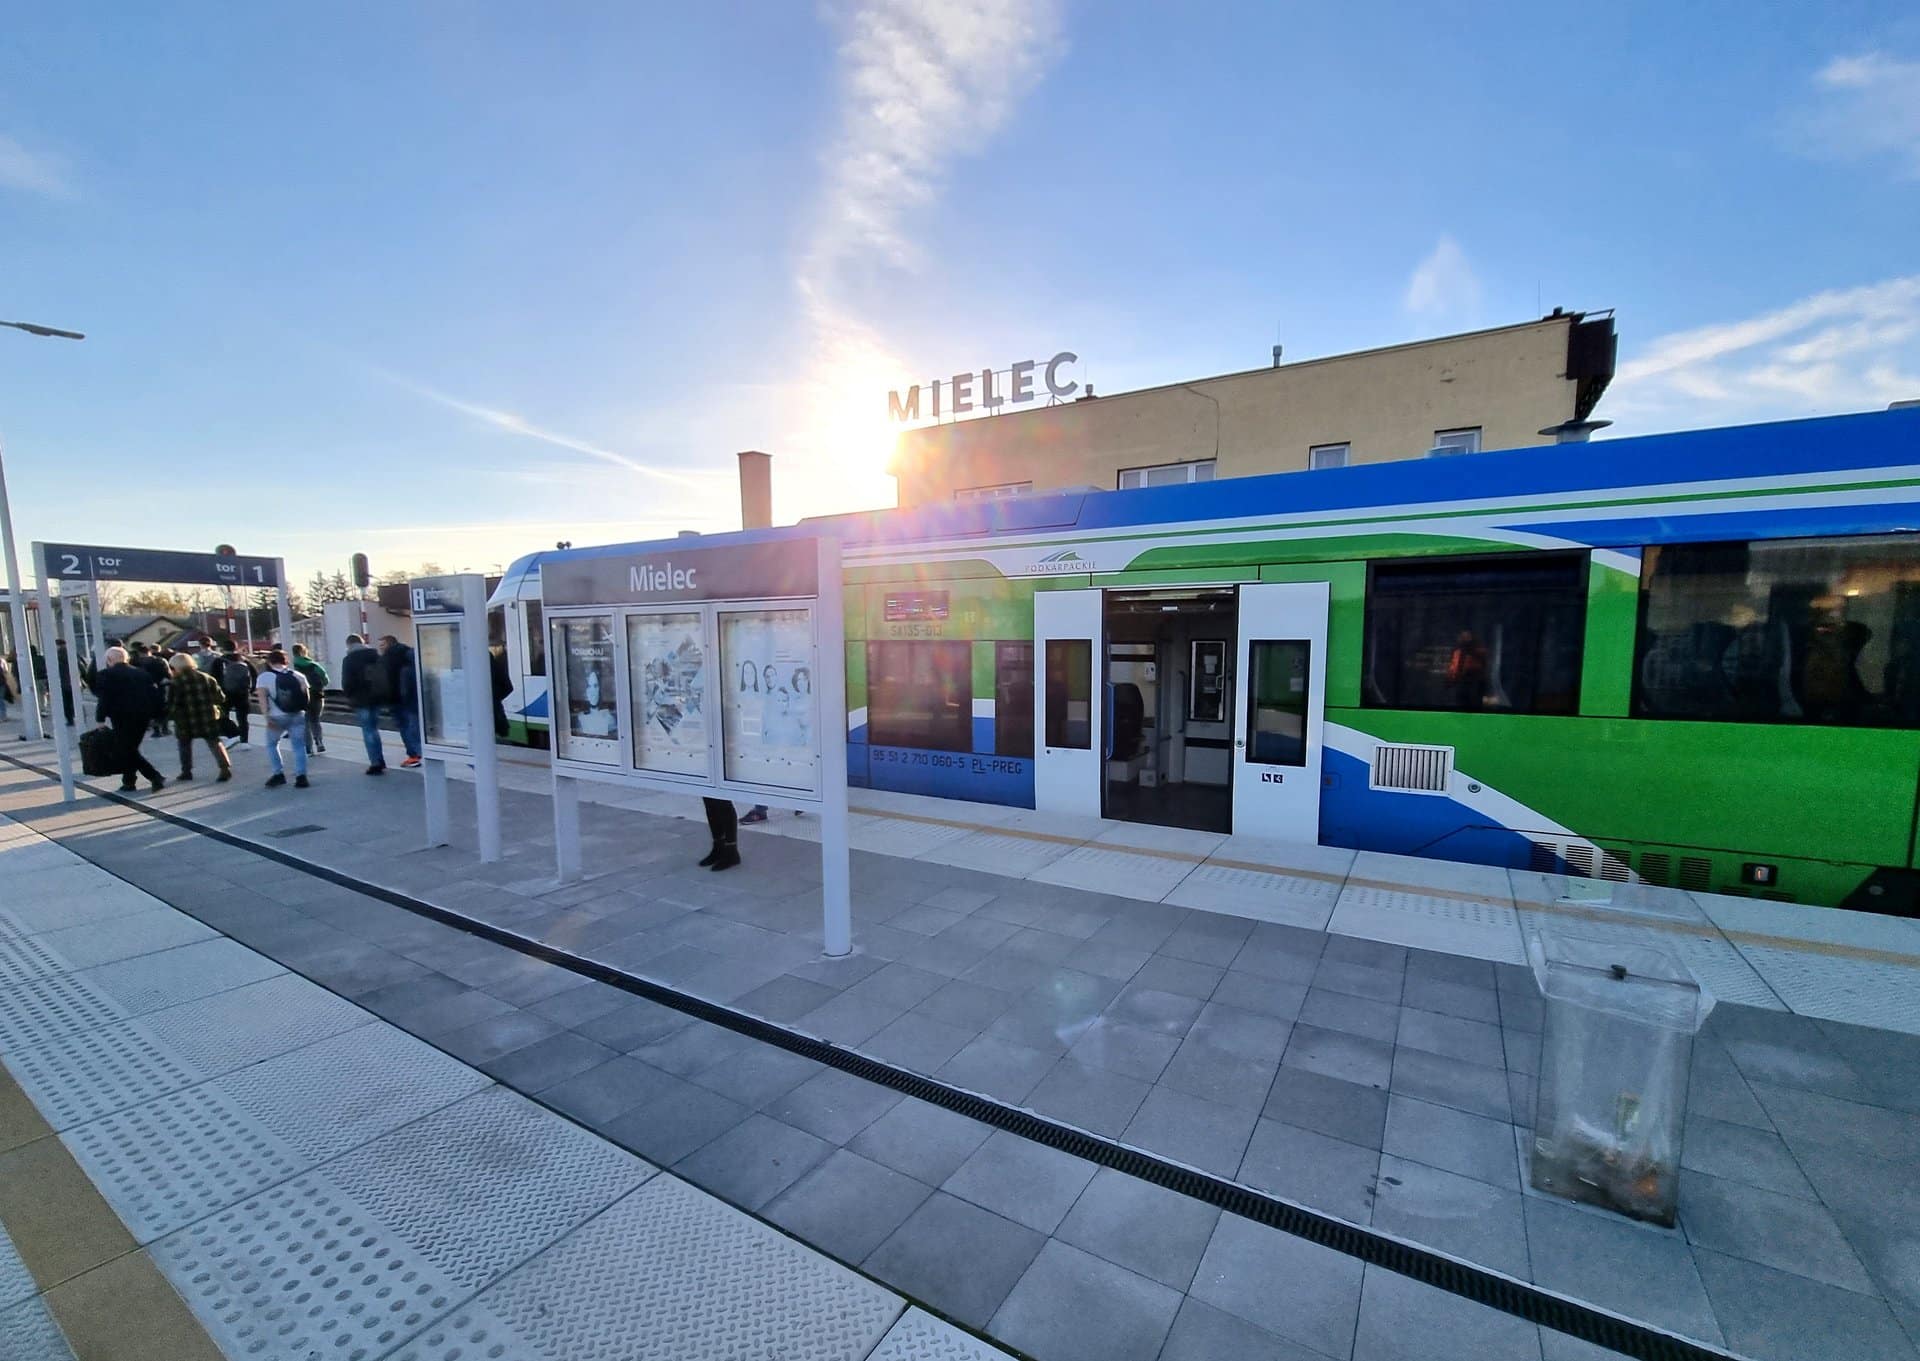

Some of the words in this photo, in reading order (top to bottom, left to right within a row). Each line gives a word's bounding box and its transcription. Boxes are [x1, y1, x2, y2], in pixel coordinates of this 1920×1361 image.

[888, 351, 1078, 421] MIELEC
[61, 554, 82, 574] 2
[98, 556, 121, 566] tor
[216, 563, 237, 573] tor
[252, 565, 264, 583] 1
[630, 561, 697, 592] Mielec
[873, 750, 885, 761] 95
[888, 750, 899, 762] 51
[901, 753, 909, 764] 2
[912, 753, 929, 765] 710
[931, 755, 965, 769] 060-5
[972, 758, 1023, 774] PL-PREG
